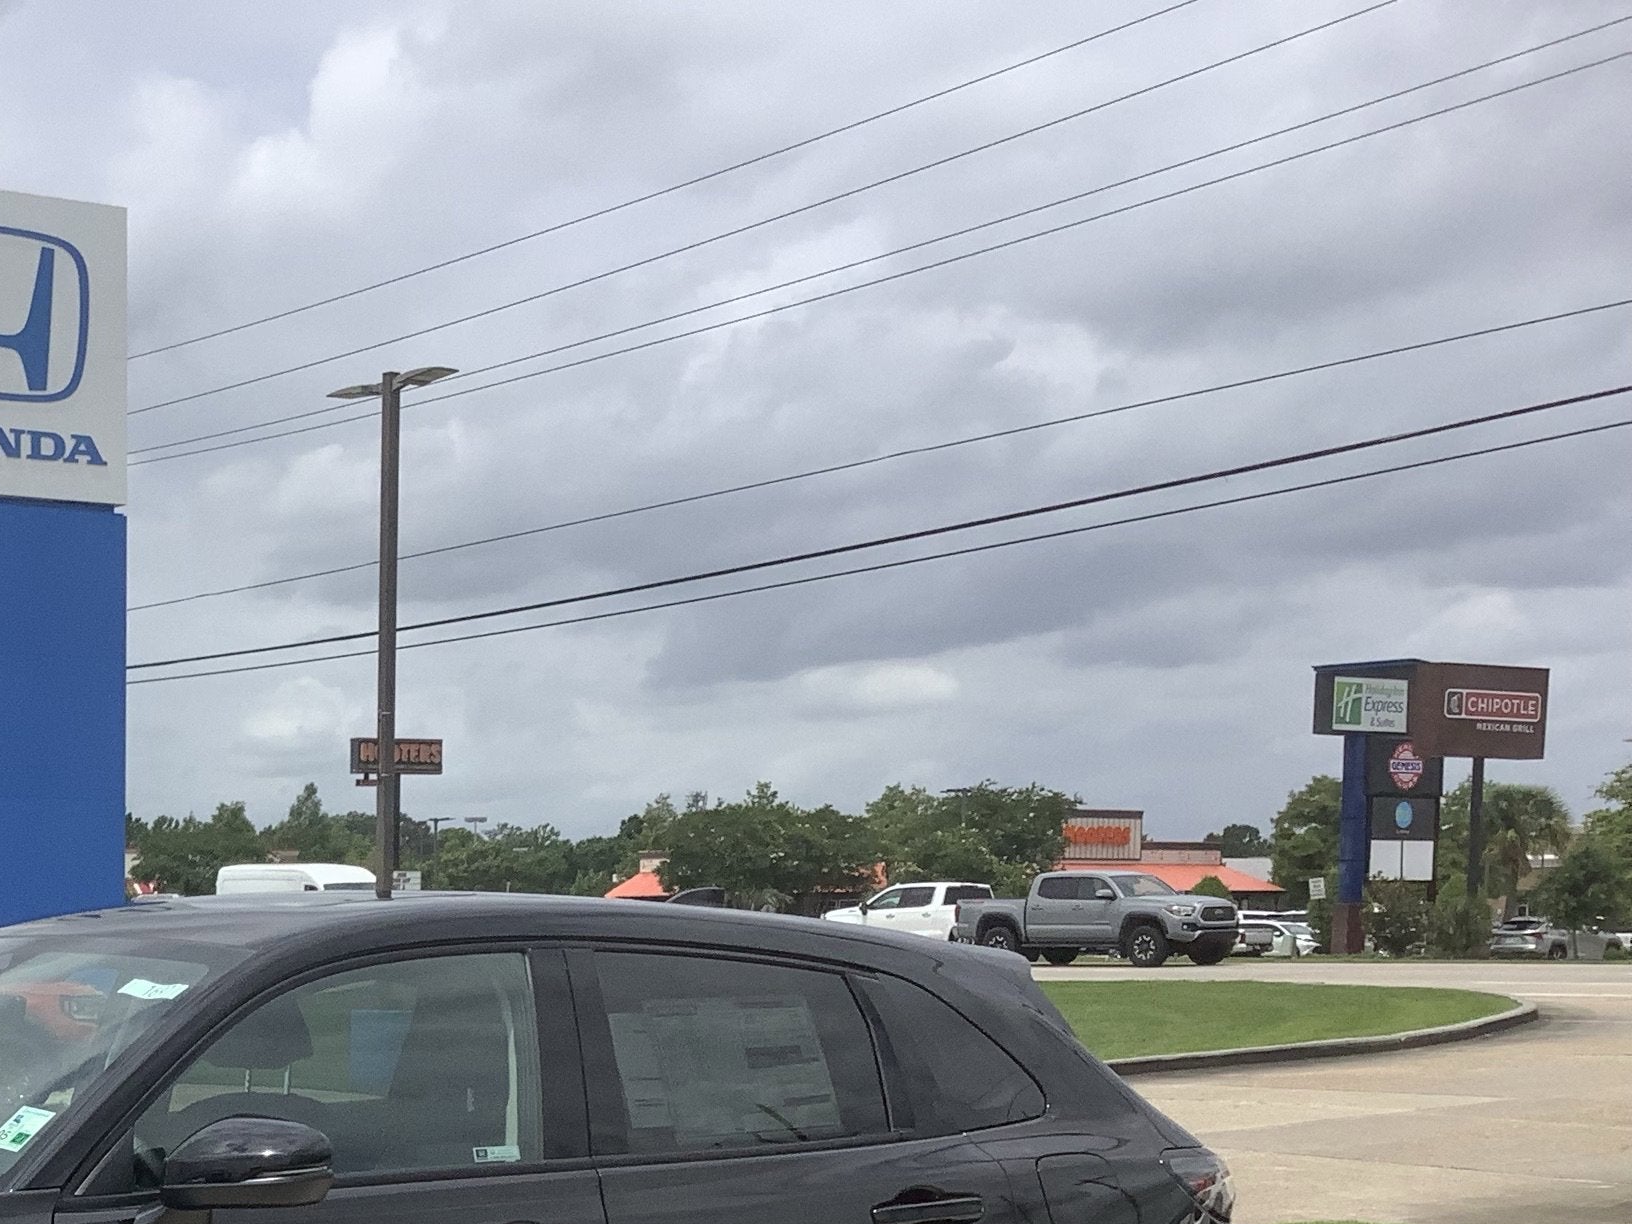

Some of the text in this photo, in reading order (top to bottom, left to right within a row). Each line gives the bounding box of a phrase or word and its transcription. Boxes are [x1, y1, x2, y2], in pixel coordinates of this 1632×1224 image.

[1364, 697, 1404, 715] Express
[1467, 697, 1536, 714] CHIPOTLE
[1476, 723, 1534, 733] MEXICAN GRILL
[359, 742, 441, 764] HOTERS
